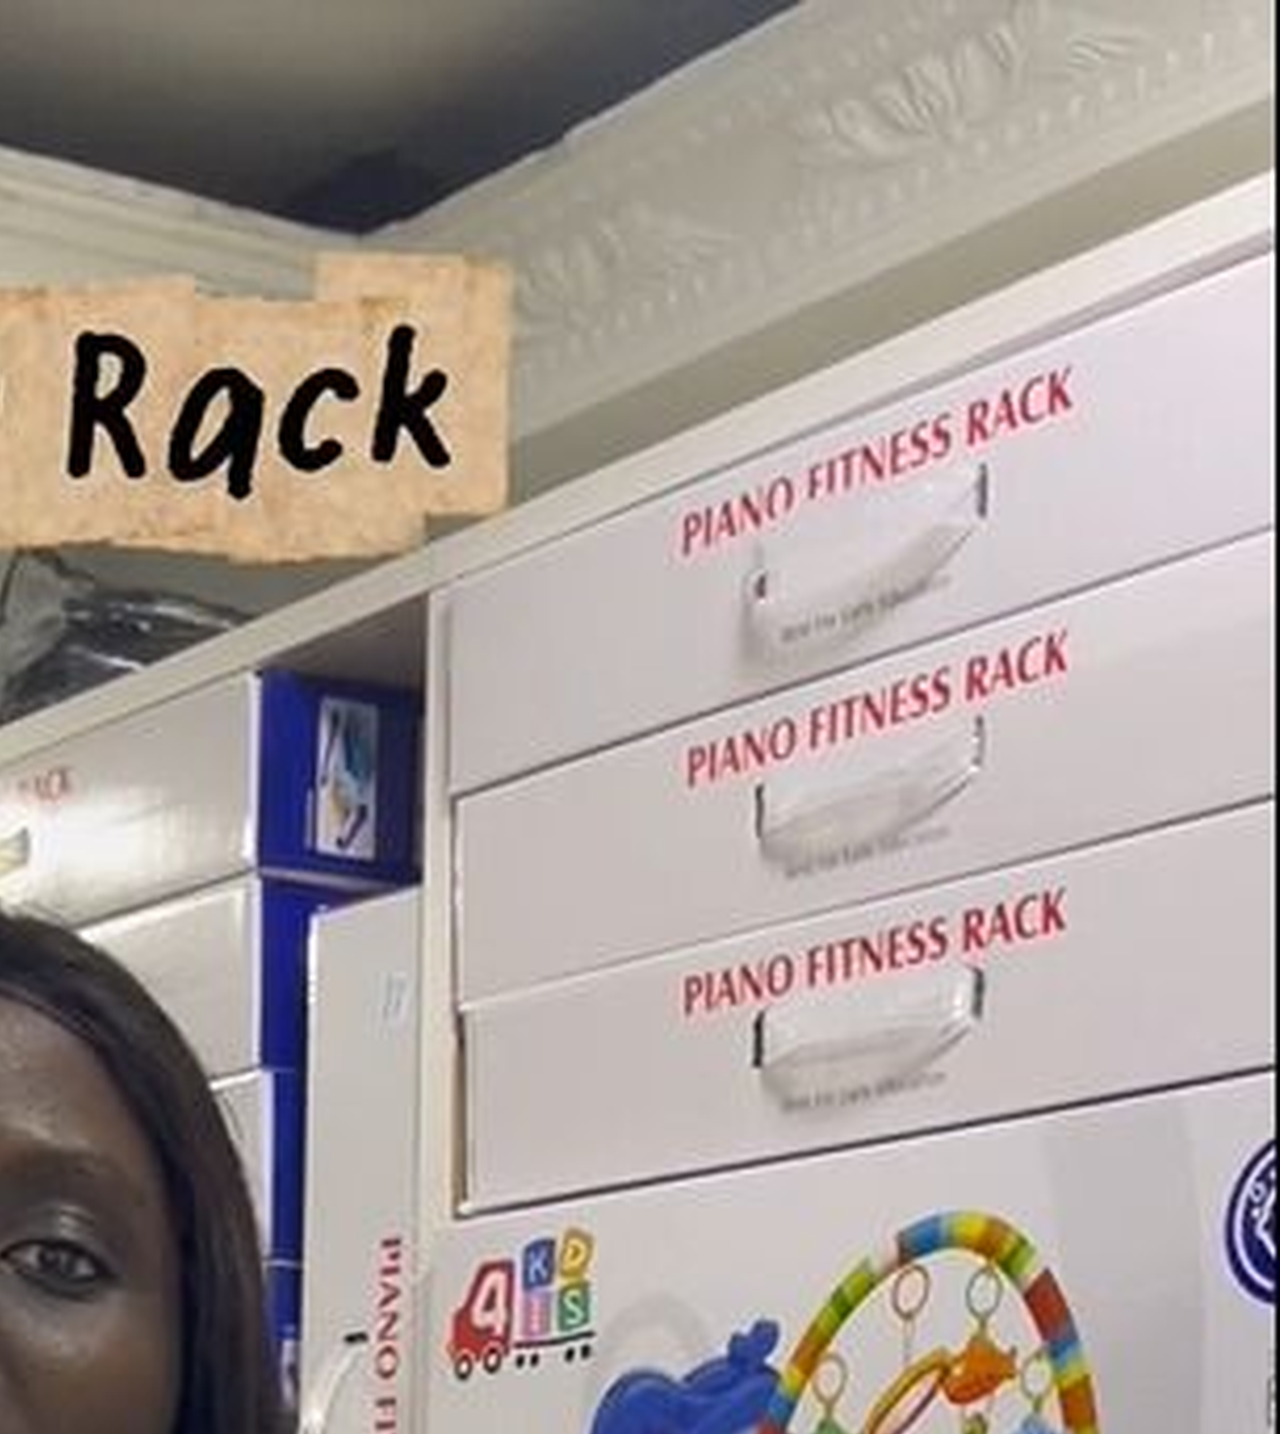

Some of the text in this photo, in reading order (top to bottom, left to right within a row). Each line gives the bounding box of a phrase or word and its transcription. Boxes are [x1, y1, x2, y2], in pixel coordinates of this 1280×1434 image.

[681, 366, 1073, 557] PIANO FITNESS RACK
[686, 631, 1068, 788] PIANO FITNESS RACK
[683, 886, 1067, 1016] PIANO FITNESS RACK
[374, 1237, 401, 1380] PIANO
